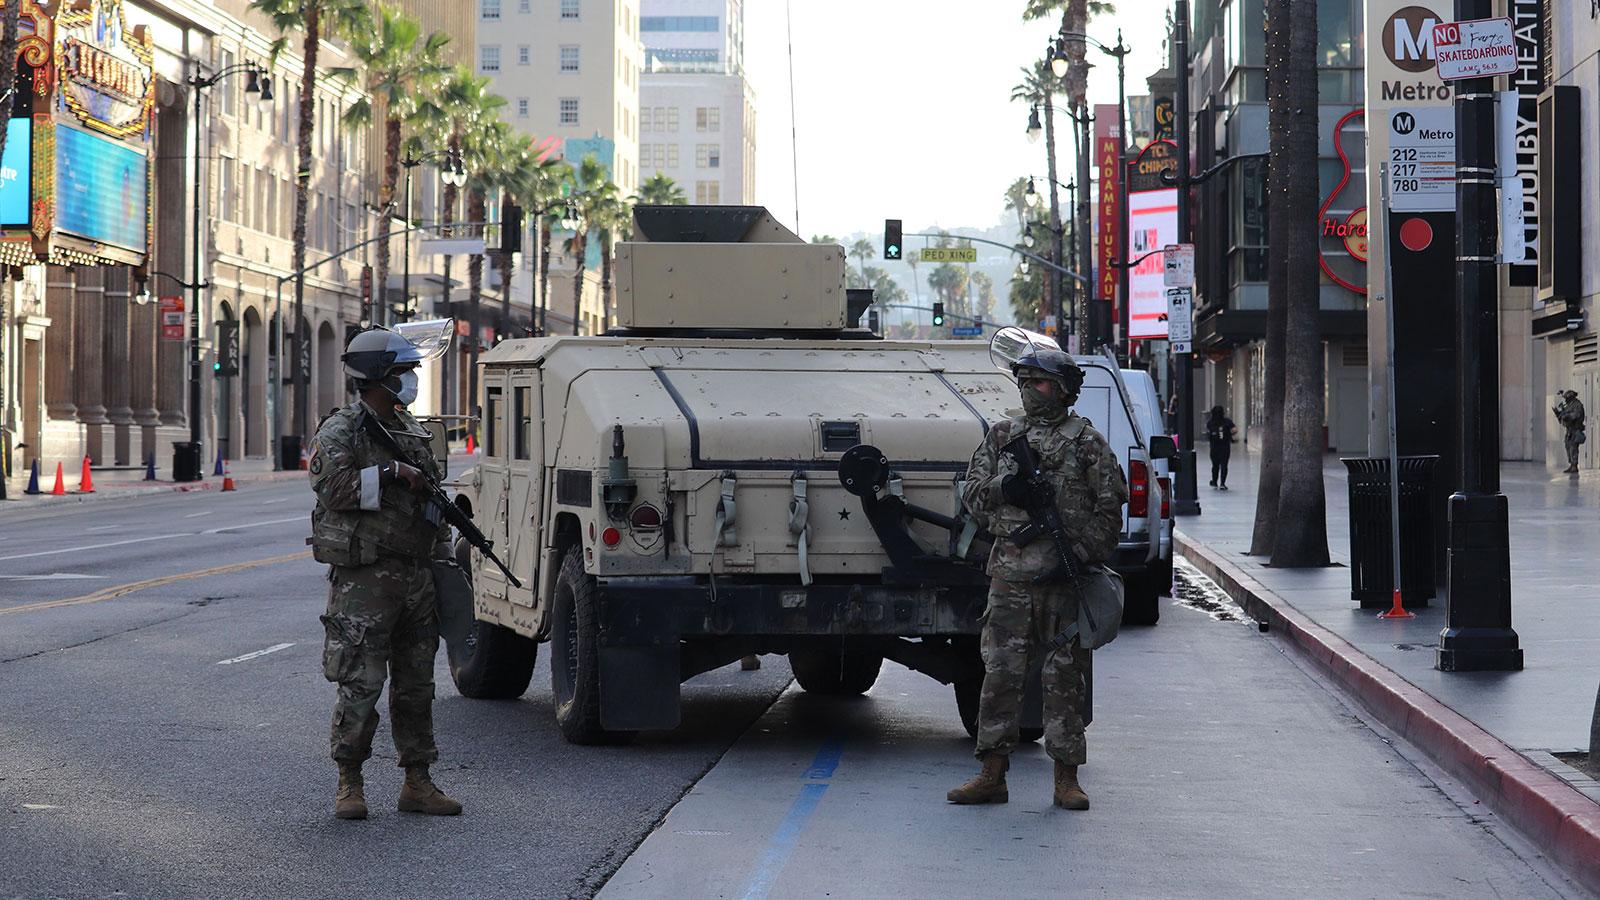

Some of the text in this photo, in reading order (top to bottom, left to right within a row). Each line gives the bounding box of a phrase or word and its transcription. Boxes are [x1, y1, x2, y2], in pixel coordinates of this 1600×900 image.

[1435, 26, 1458, 44] NO
[1439, 45, 1513, 63] SKATEBOARDING
[1381, 80, 1451, 101] Metro
[1419, 128, 1454, 140] Metro
[1392, 148, 1418, 162] 212
[1103, 142, 1114, 216] MADAME
[1393, 163, 1417, 177] 217
[1393, 179, 1419, 192] 780
[924, 250, 973, 260] PED XING
[1104, 223, 1113, 300] TUSSAU
[228, 327, 238, 369] ZARA
